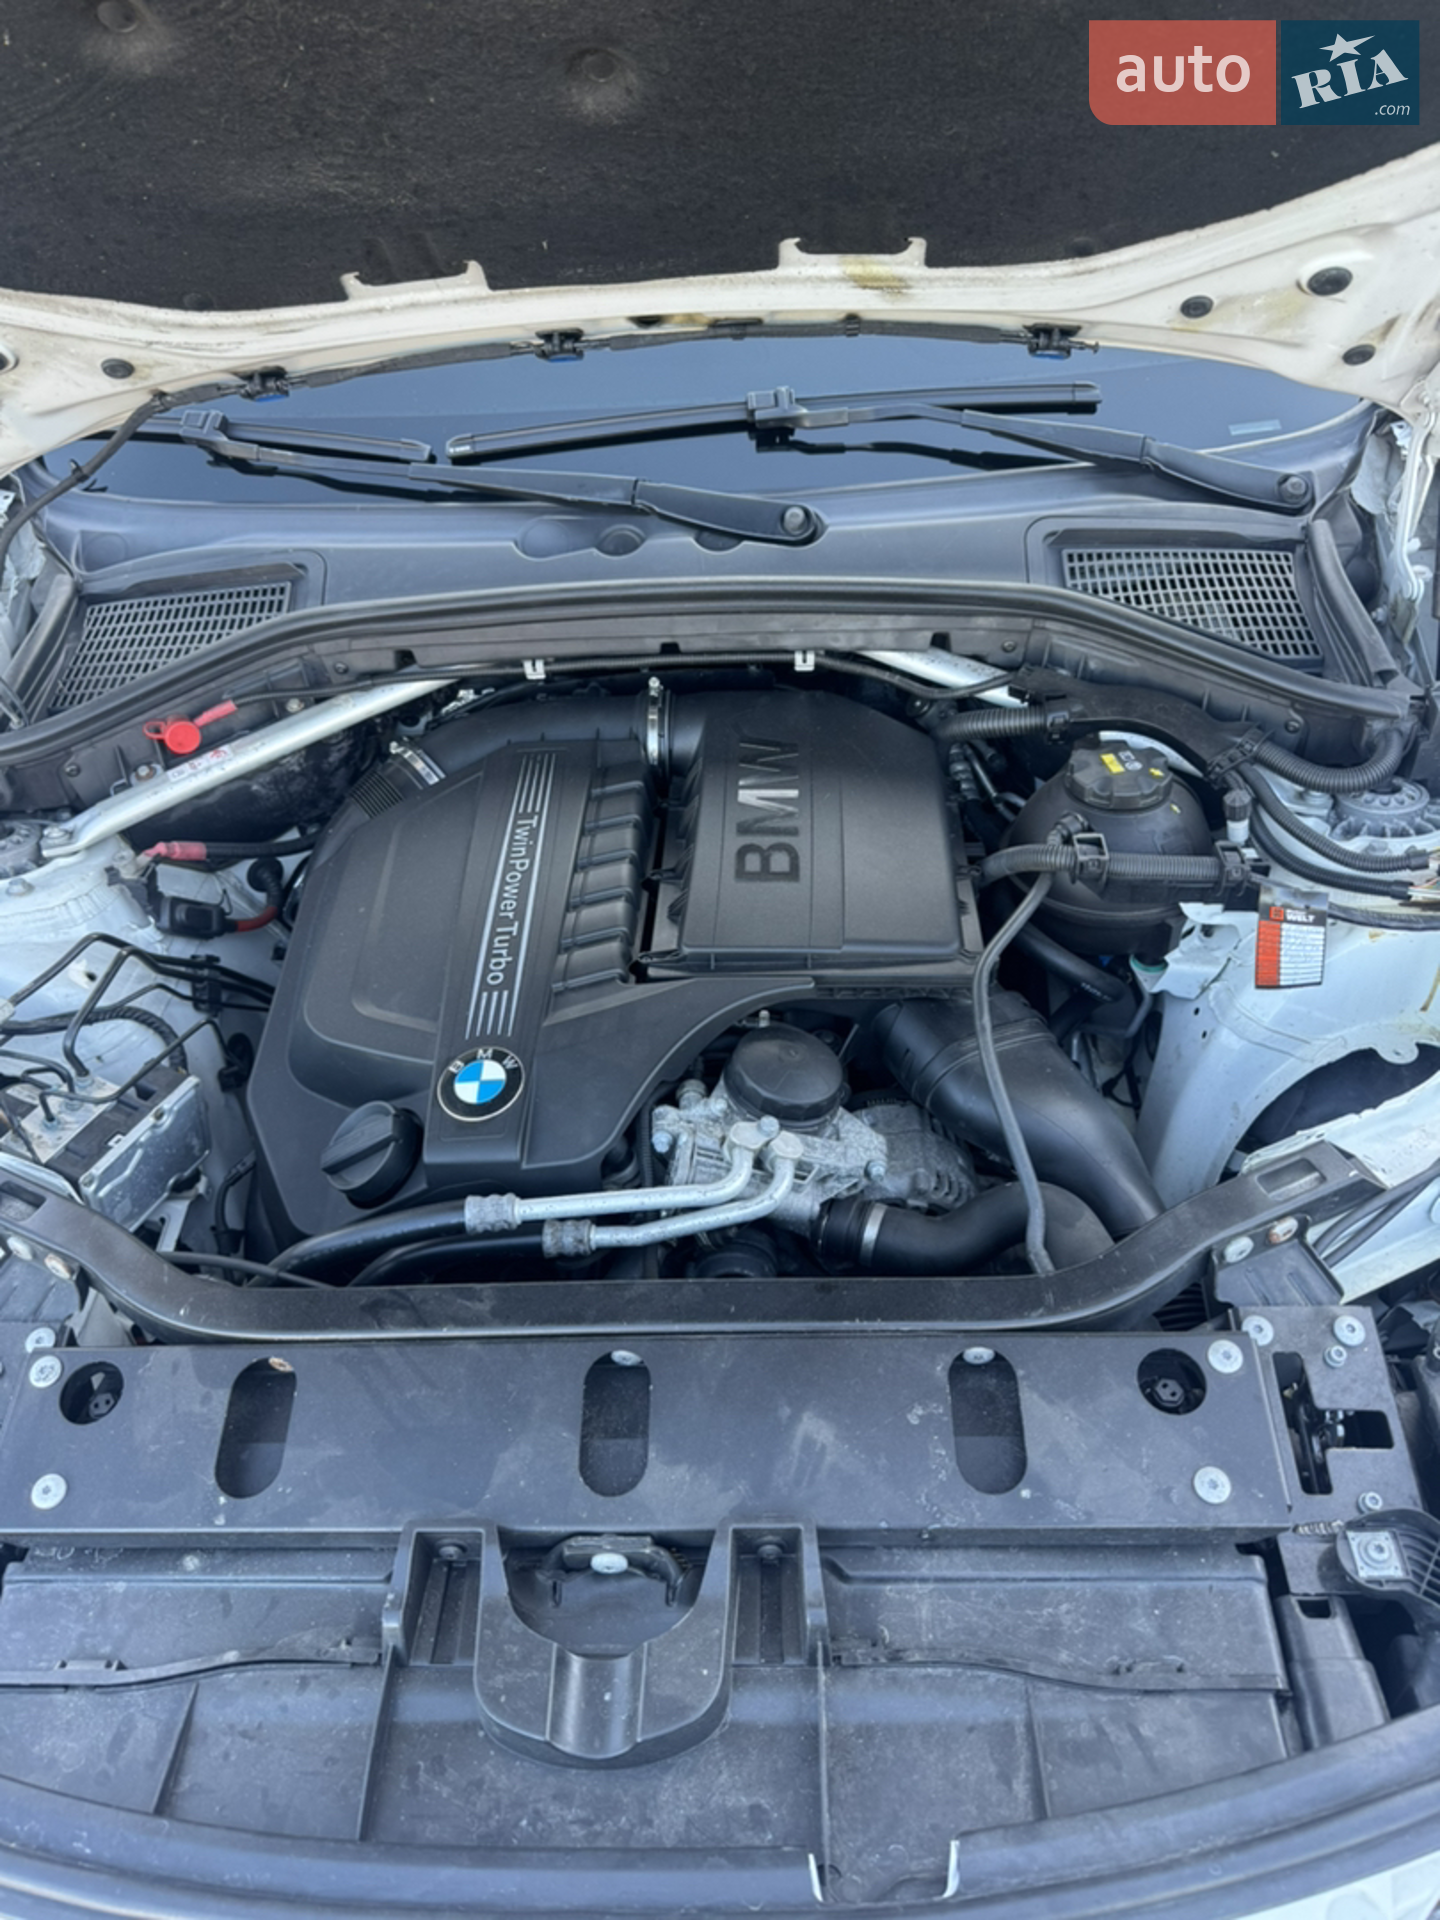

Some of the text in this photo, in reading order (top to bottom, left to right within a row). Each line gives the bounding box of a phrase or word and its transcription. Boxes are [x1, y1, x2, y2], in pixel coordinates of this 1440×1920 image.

[735, 738, 800, 882] BMW
[486, 814, 538, 986] TwinPower Turbo
[449, 1048, 518, 1074] BMW
